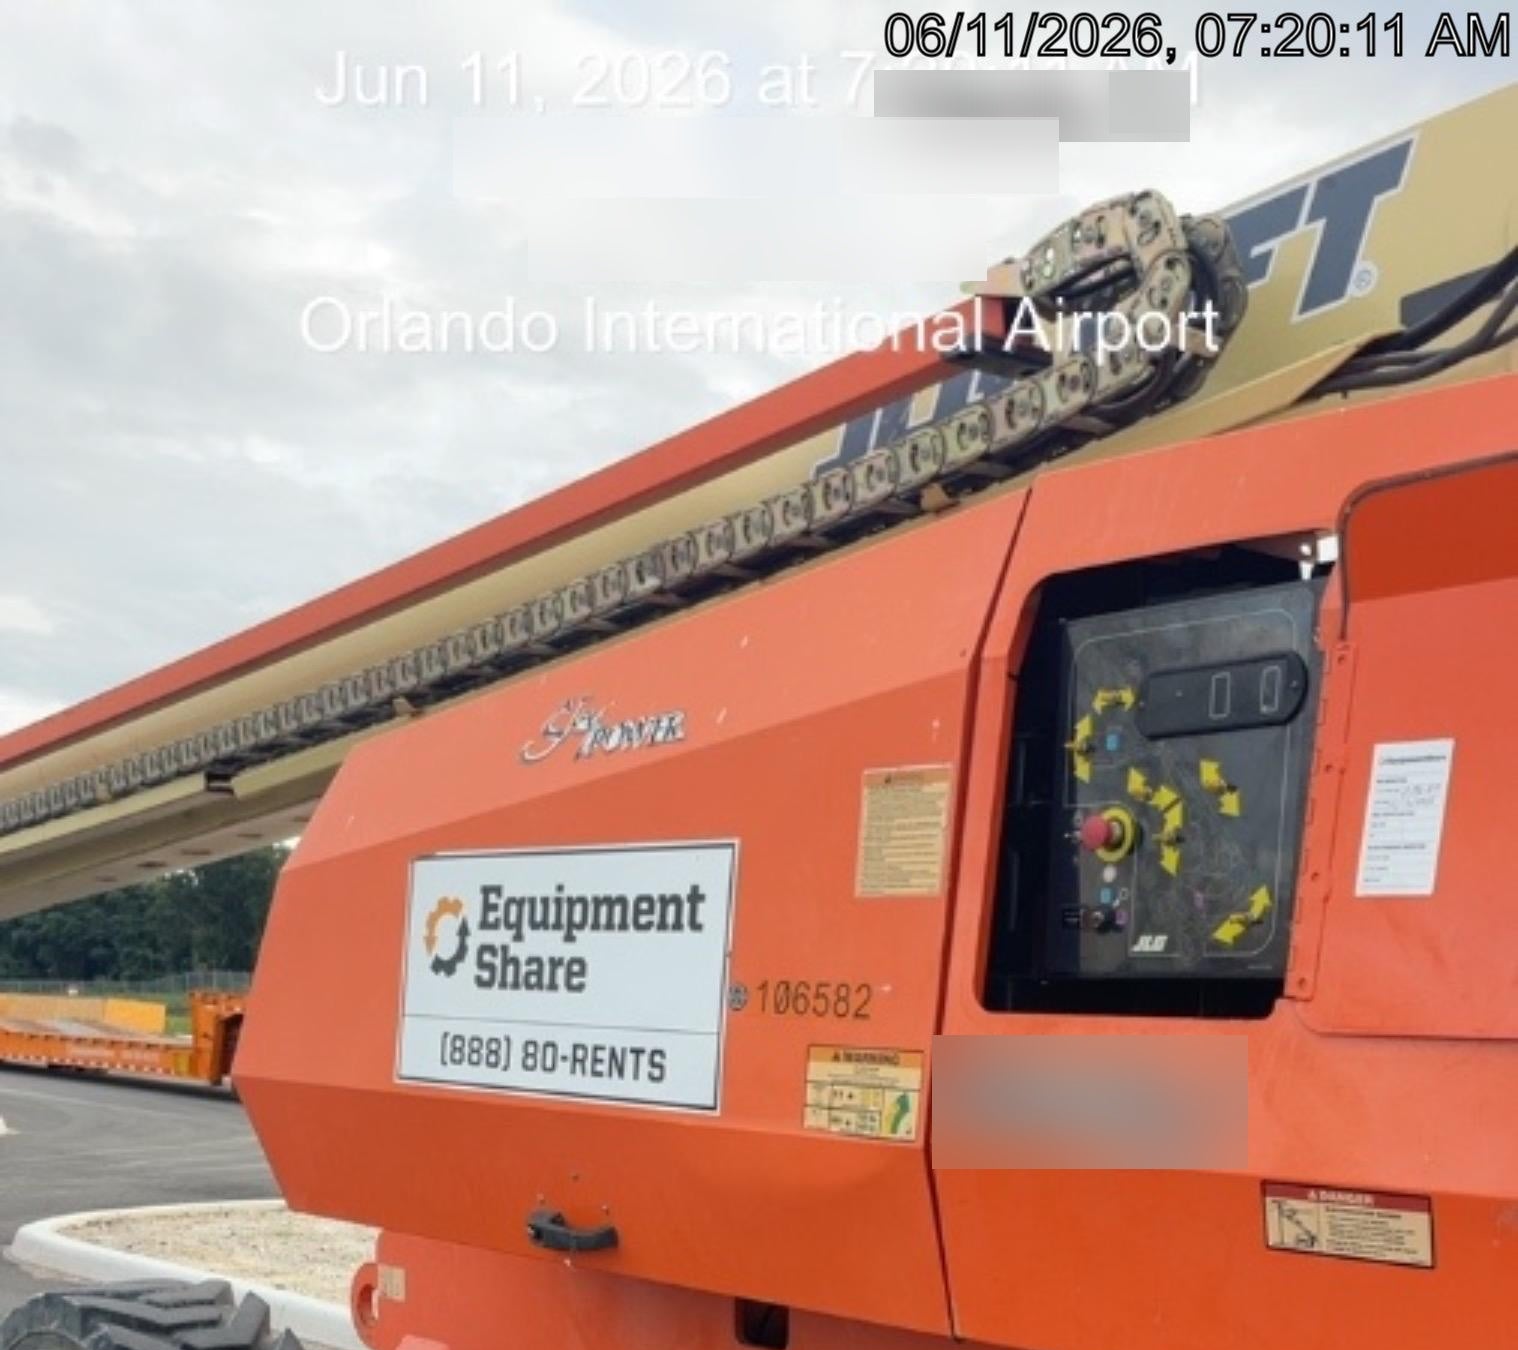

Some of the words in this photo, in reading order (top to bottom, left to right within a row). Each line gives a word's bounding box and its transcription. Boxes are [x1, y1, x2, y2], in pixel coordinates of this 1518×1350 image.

[478, 883, 706, 943] Equipment
[474, 943, 588, 993] Share
[756, 979, 873, 1019] 106582
[440, 1031, 512, 1072] (888)
[521, 1040, 667, 1084] 80-RENTS
